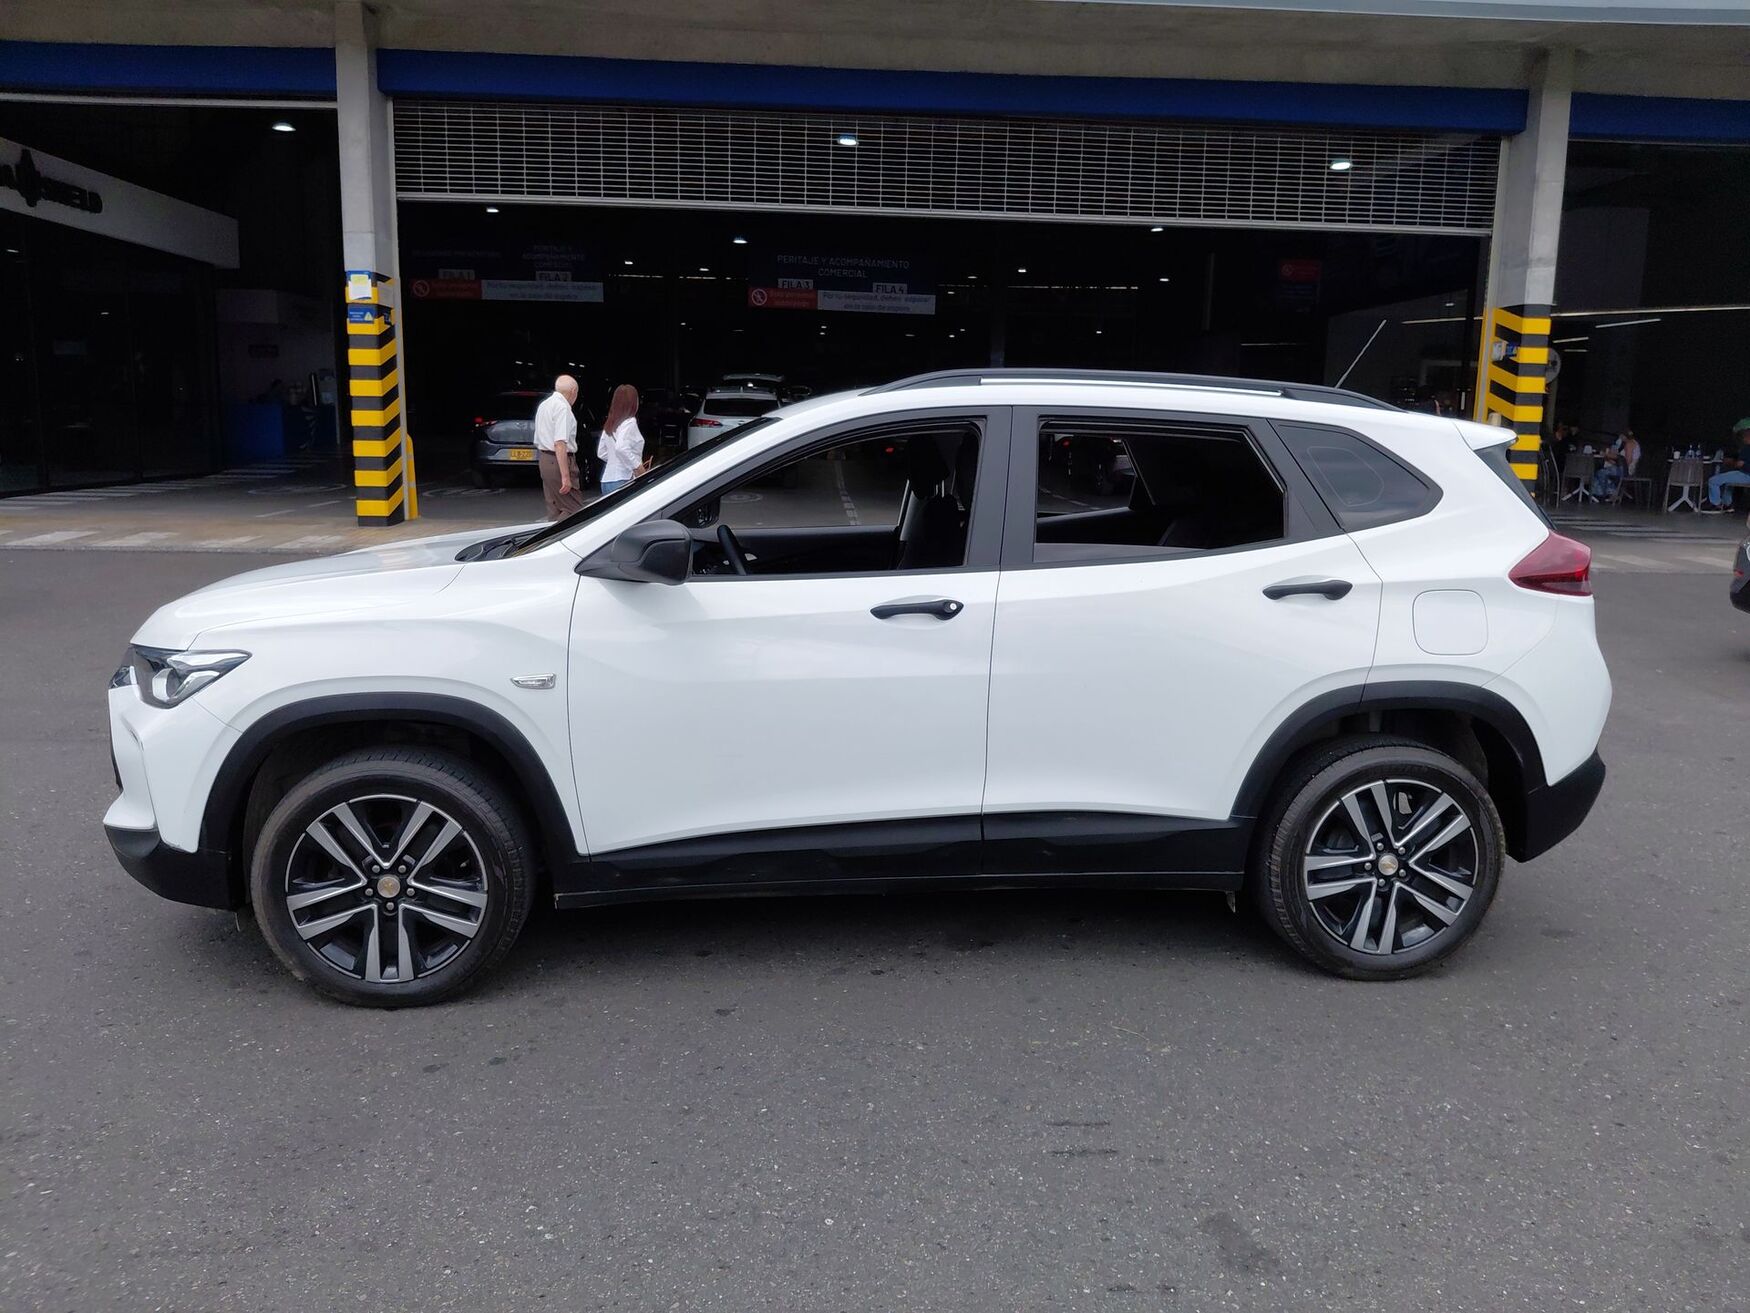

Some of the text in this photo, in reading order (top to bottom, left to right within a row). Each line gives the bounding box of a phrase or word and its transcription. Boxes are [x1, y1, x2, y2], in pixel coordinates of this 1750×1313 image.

[817, 267, 868, 279] COMERCIAL
[782, 279, 802, 289] FILA
[875, 283, 896, 294] FILA
